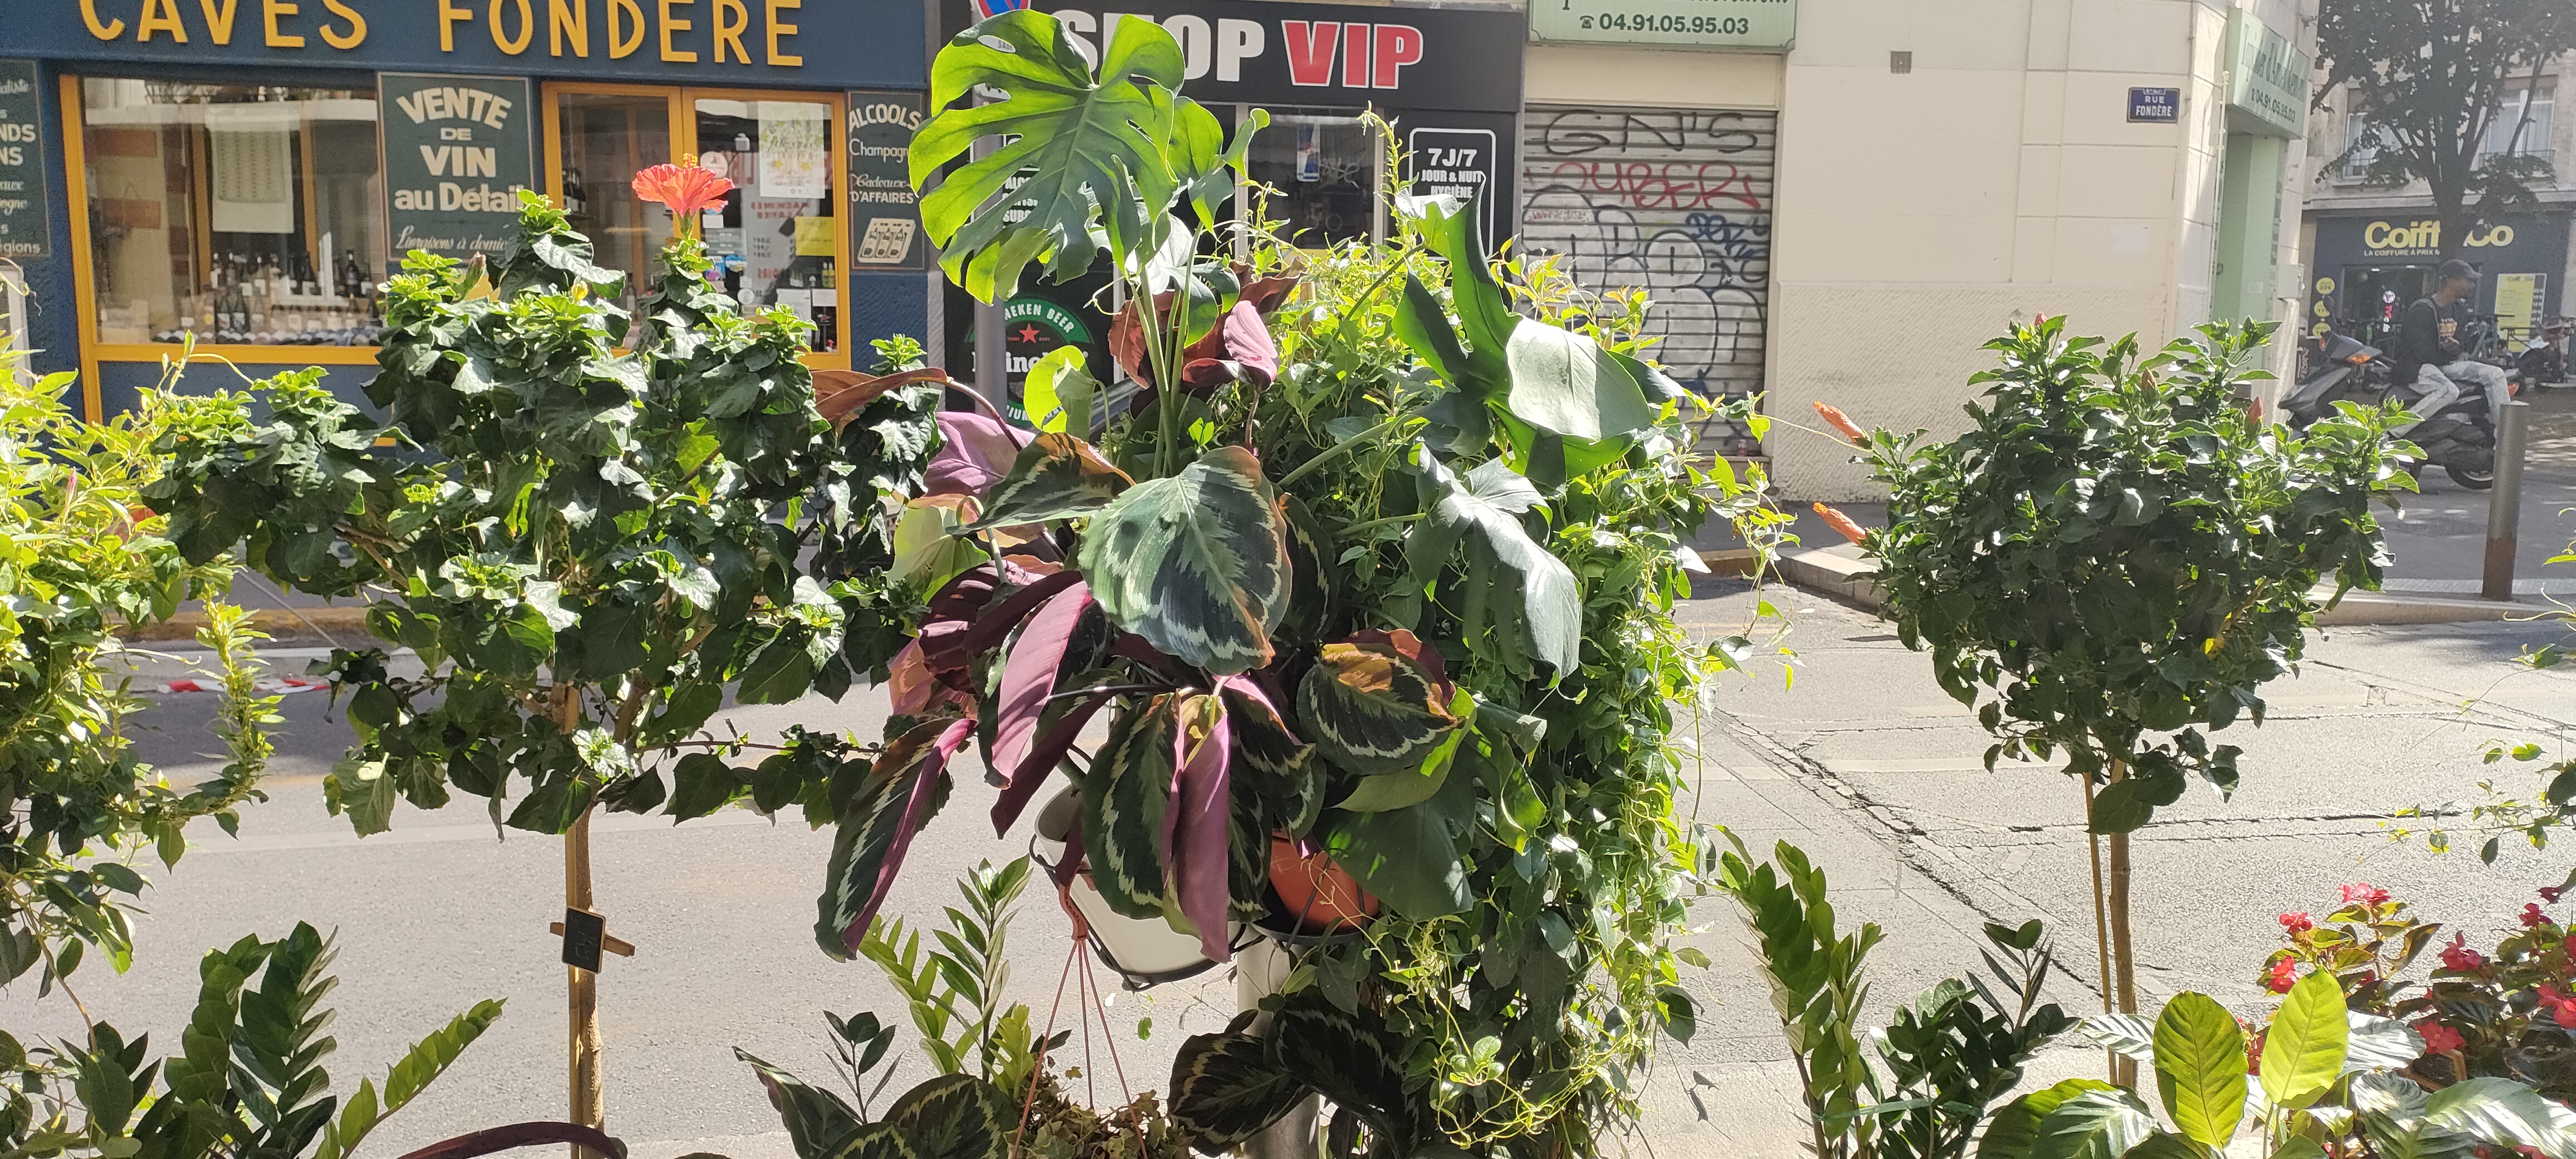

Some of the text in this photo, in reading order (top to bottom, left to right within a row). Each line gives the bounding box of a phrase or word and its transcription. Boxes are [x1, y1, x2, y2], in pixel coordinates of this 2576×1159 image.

[79, 0, 803, 66] CAVES FONDERE
[1599, 13, 1749, 35] 04.91.05.95.03
[1051, 9, 1423, 89] SOP VIP
[396, 87, 512, 130] VENTE
[2145, 95, 2165, 104] RUE
[848, 104, 921, 133] ALCOOLS
[441, 127, 472, 140] DE
[419, 145, 496, 178] VIN
[848, 138, 910, 163] Champagn
[1428, 148, 1477, 167] 7J/7
[1421, 169, 1482, 183] JOUR & NUIT
[394, 189, 433, 211] au
[850, 191, 914, 204] D'AFFAIRES
[1004, 303, 1075, 334] NEKEN BEER
